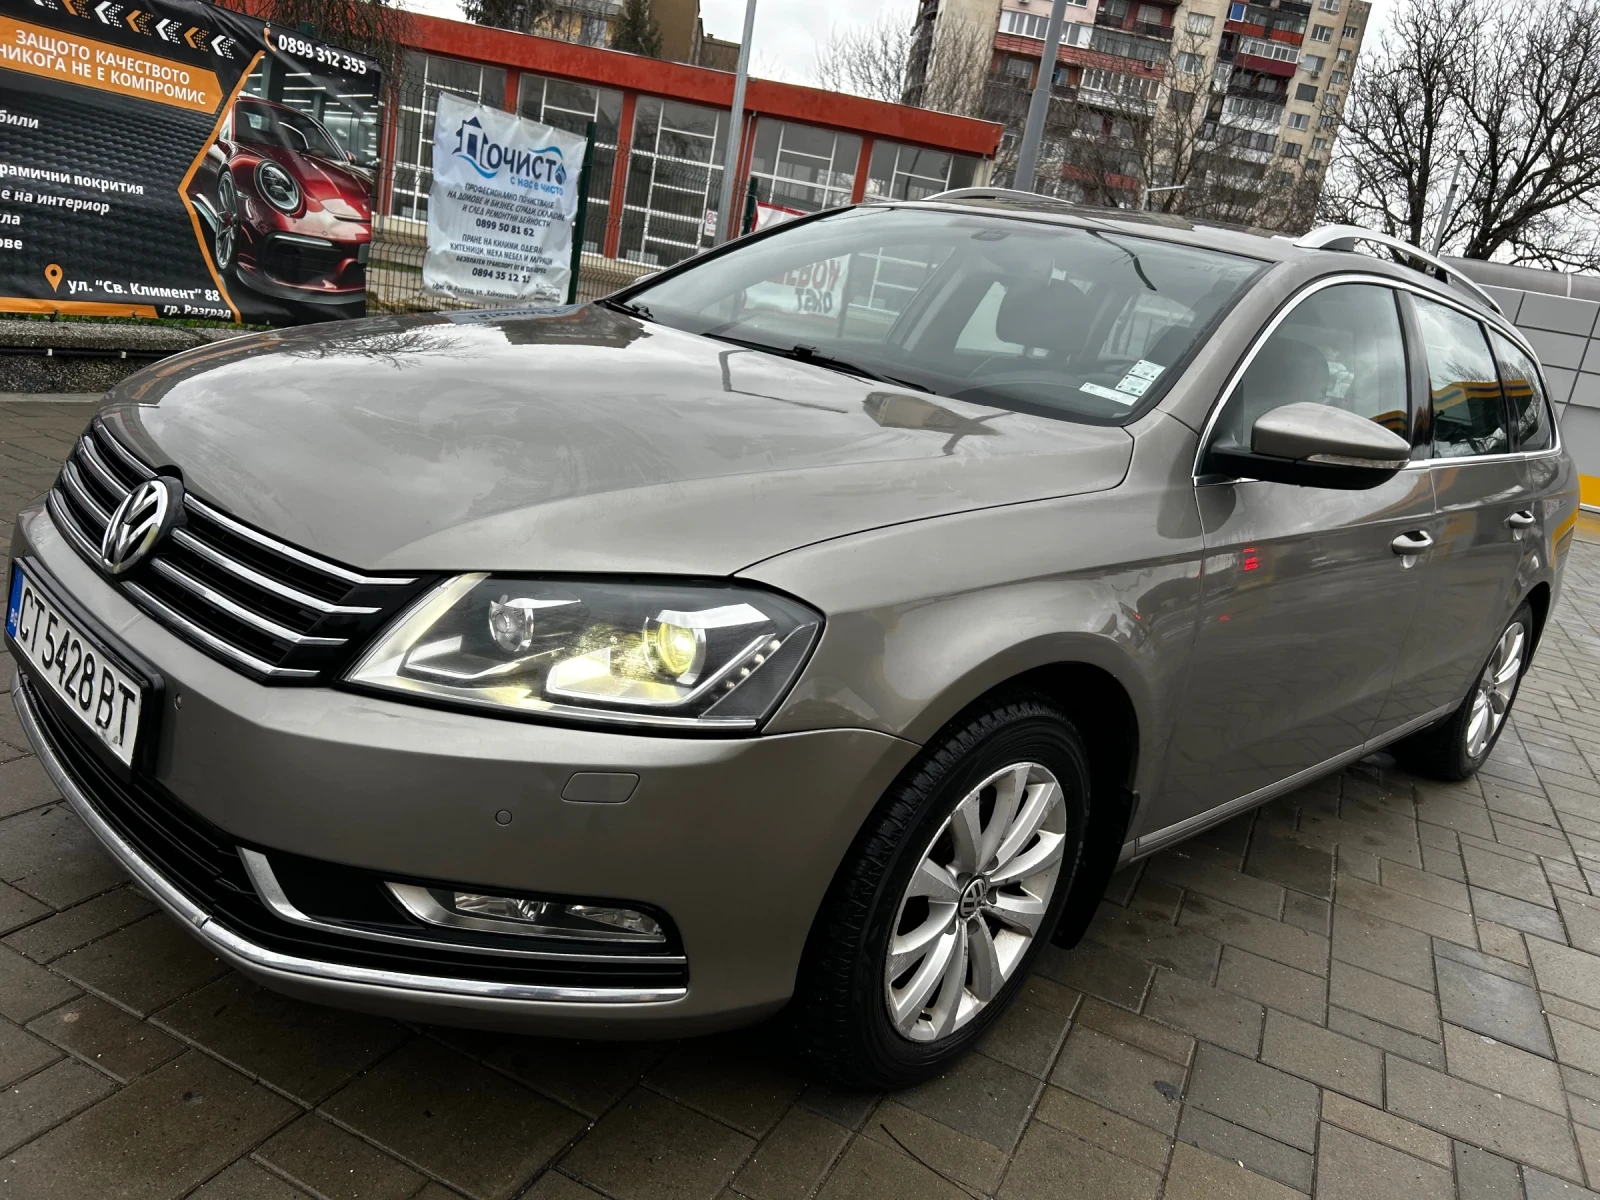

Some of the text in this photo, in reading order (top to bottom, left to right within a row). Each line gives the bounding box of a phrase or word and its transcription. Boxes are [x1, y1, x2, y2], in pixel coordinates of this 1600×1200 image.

[16, 29, 190, 85] ЗАЩОТО КАЧЕСТВОТО
[278, 34, 367, 75] 0899 312 355
[0, 43, 206, 105] НИКОГА НЕ Е КОМПРОМИС
[73, 175, 144, 195] покрития
[518, 178, 533, 190] нас
[540, 183, 564, 196] чисто
[14, 191, 33, 203] на
[37, 194, 110, 216] интериор
[447, 190, 457, 199] НА
[457, 193, 482, 205] ДОМОВЕ
[483, 198, 489, 206] И
[490, 200, 514, 211] БИЗНЕС
[0, 213, 20, 225] ла
[462, 204, 468, 212] И
[468, 205, 485, 216] СЛЕД
[485, 209, 518, 221] РЕМОНТНИ
[476, 218, 534, 237] 0899 50 81 62
[462, 234, 482, 245] ПРАНЕ
[483, 238, 492, 246] НА
[472, 267, 493, 279] 0894
[495, 271, 506, 281] 35
[508, 273, 519, 283] 12
[67, 279, 93, 294] ул.
[204, 289, 220, 302] 88
[163, 304, 232, 319] гр. Разград
